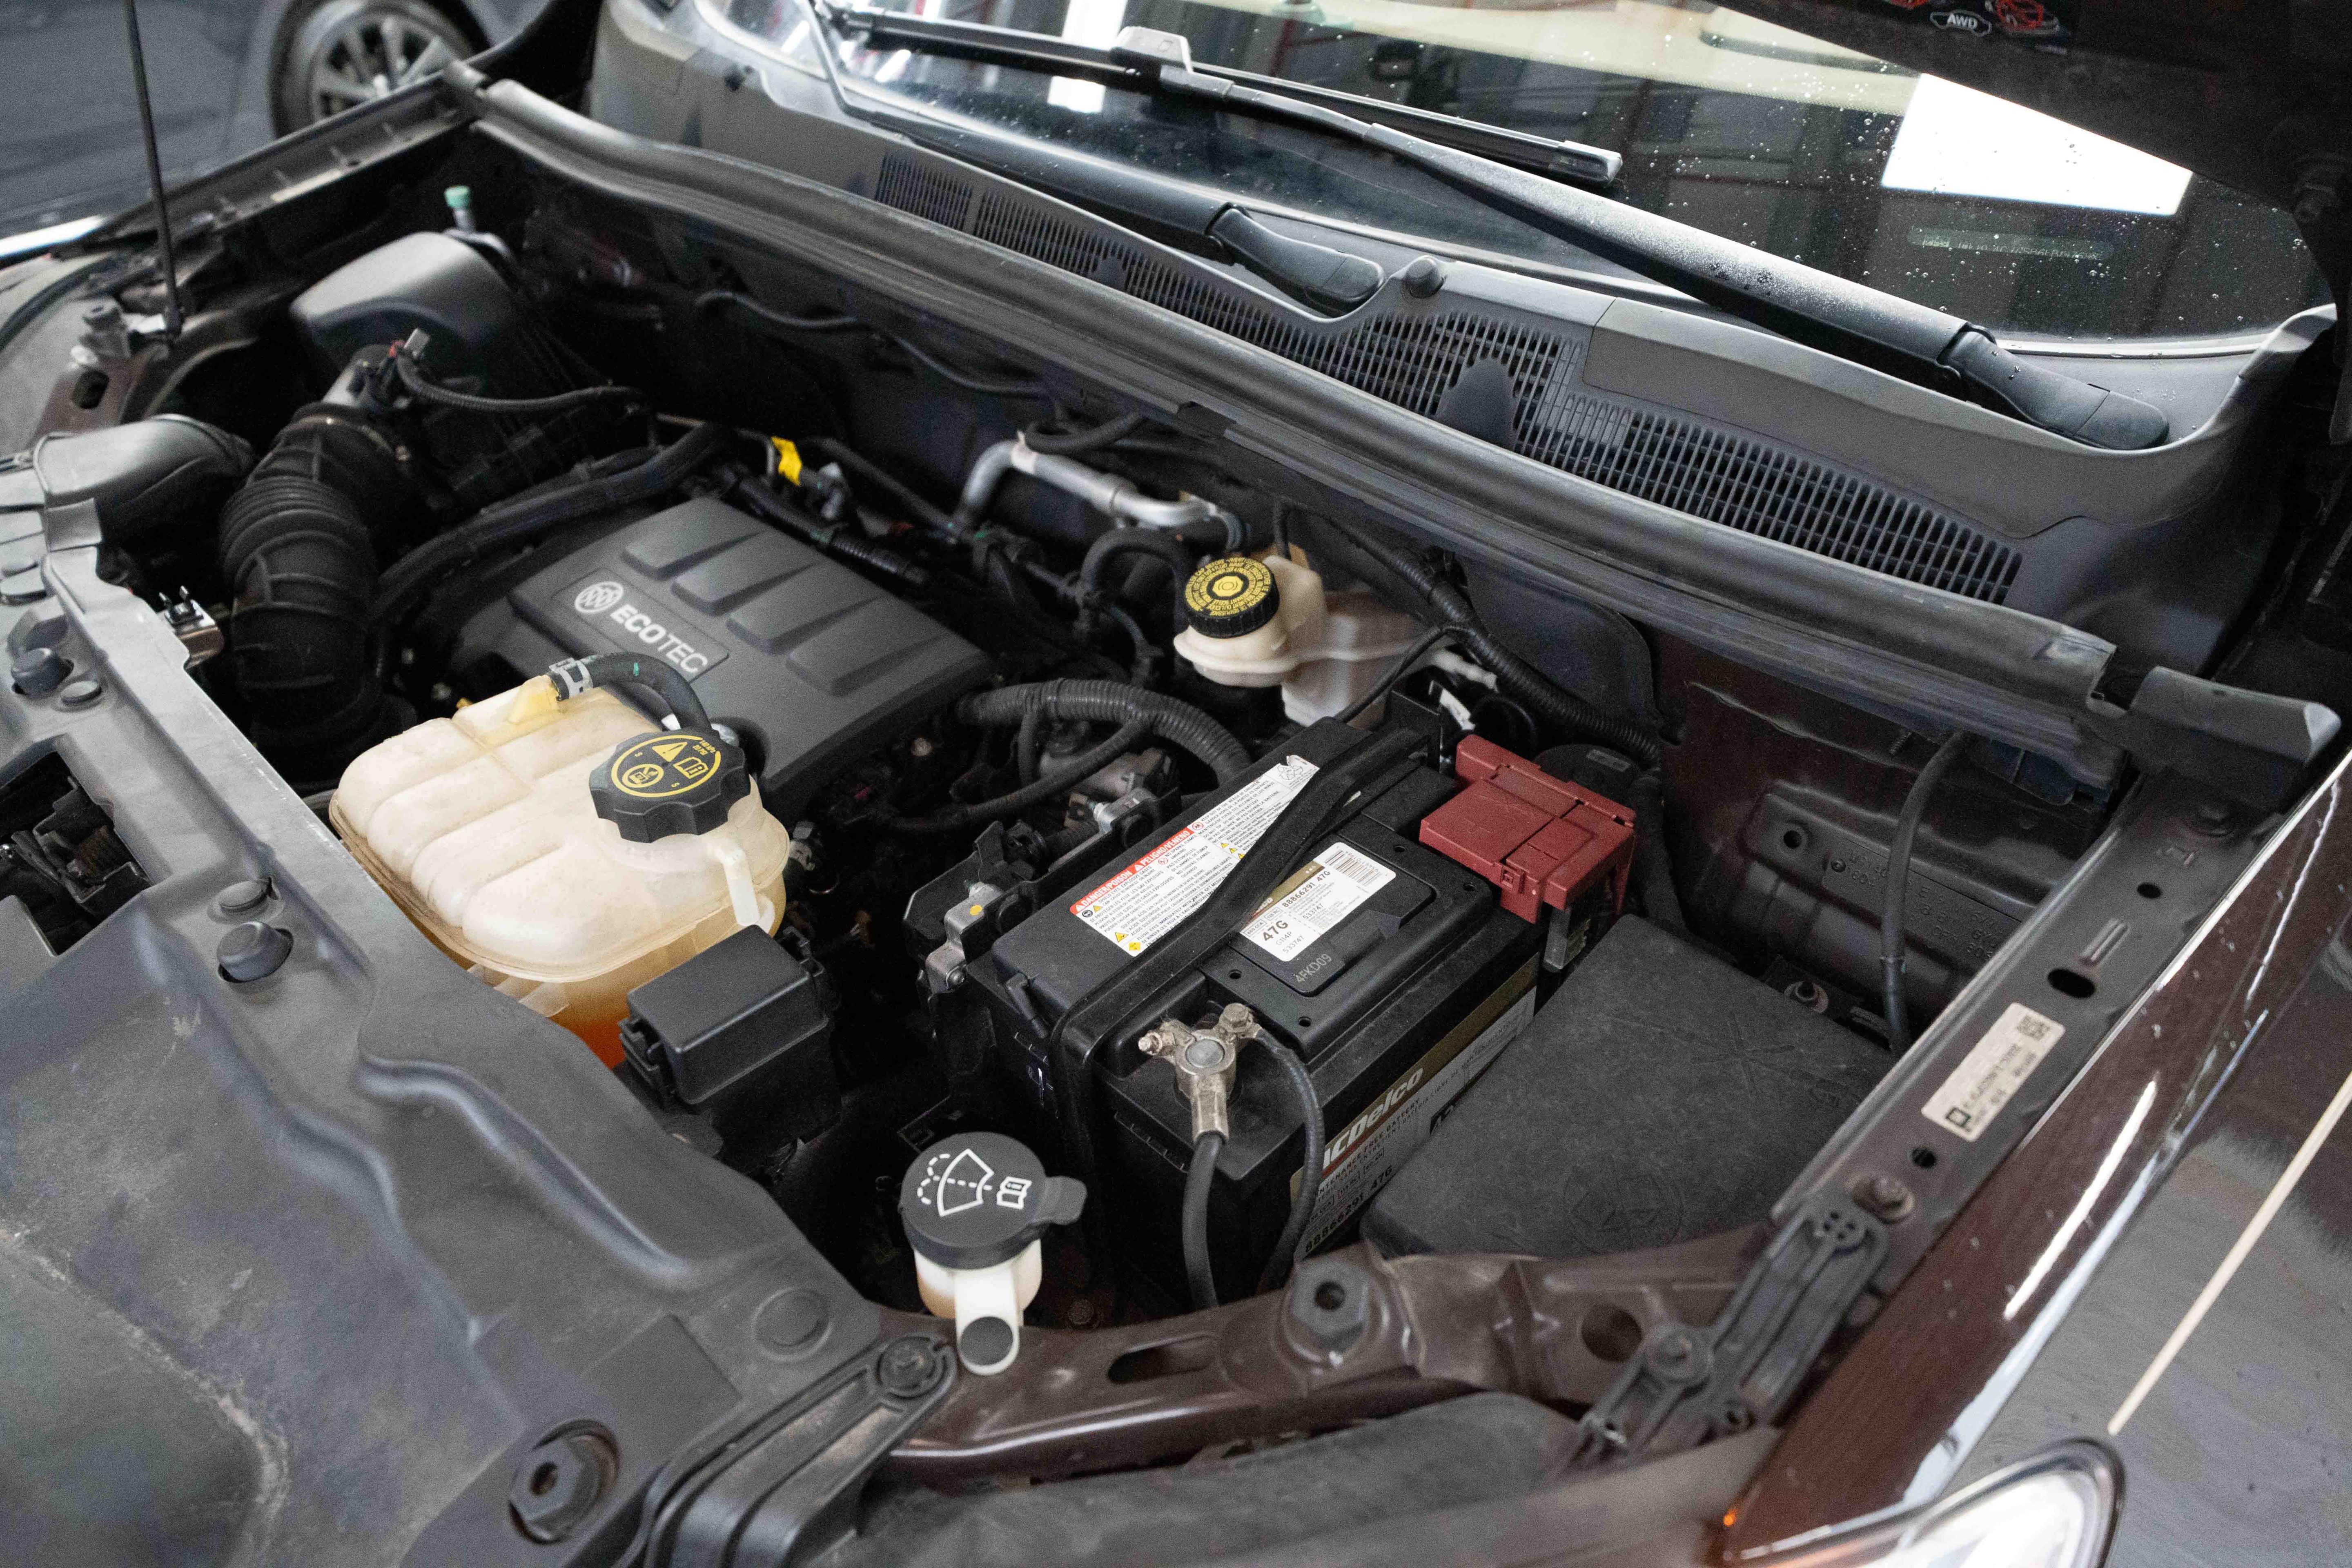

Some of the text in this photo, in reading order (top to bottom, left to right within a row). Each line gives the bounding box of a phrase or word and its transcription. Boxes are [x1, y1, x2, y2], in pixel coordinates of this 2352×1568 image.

[1947, 13, 1979, 30] AWD
[610, 603, 708, 673] ECOTEC
[1139, 829, 1192, 866] PELIGRO/VENENO
[1080, 870, 1133, 906] DANGER/POISON
[1282, 882, 1315, 908] 88866291
[1316, 870, 1330, 882] 47G
[1262, 920, 1289, 942] 47G
[1276, 931, 1292, 945] G114P
[1283, 935, 1304, 953] 533747
[1295, 953, 1332, 982] 4FKD09
